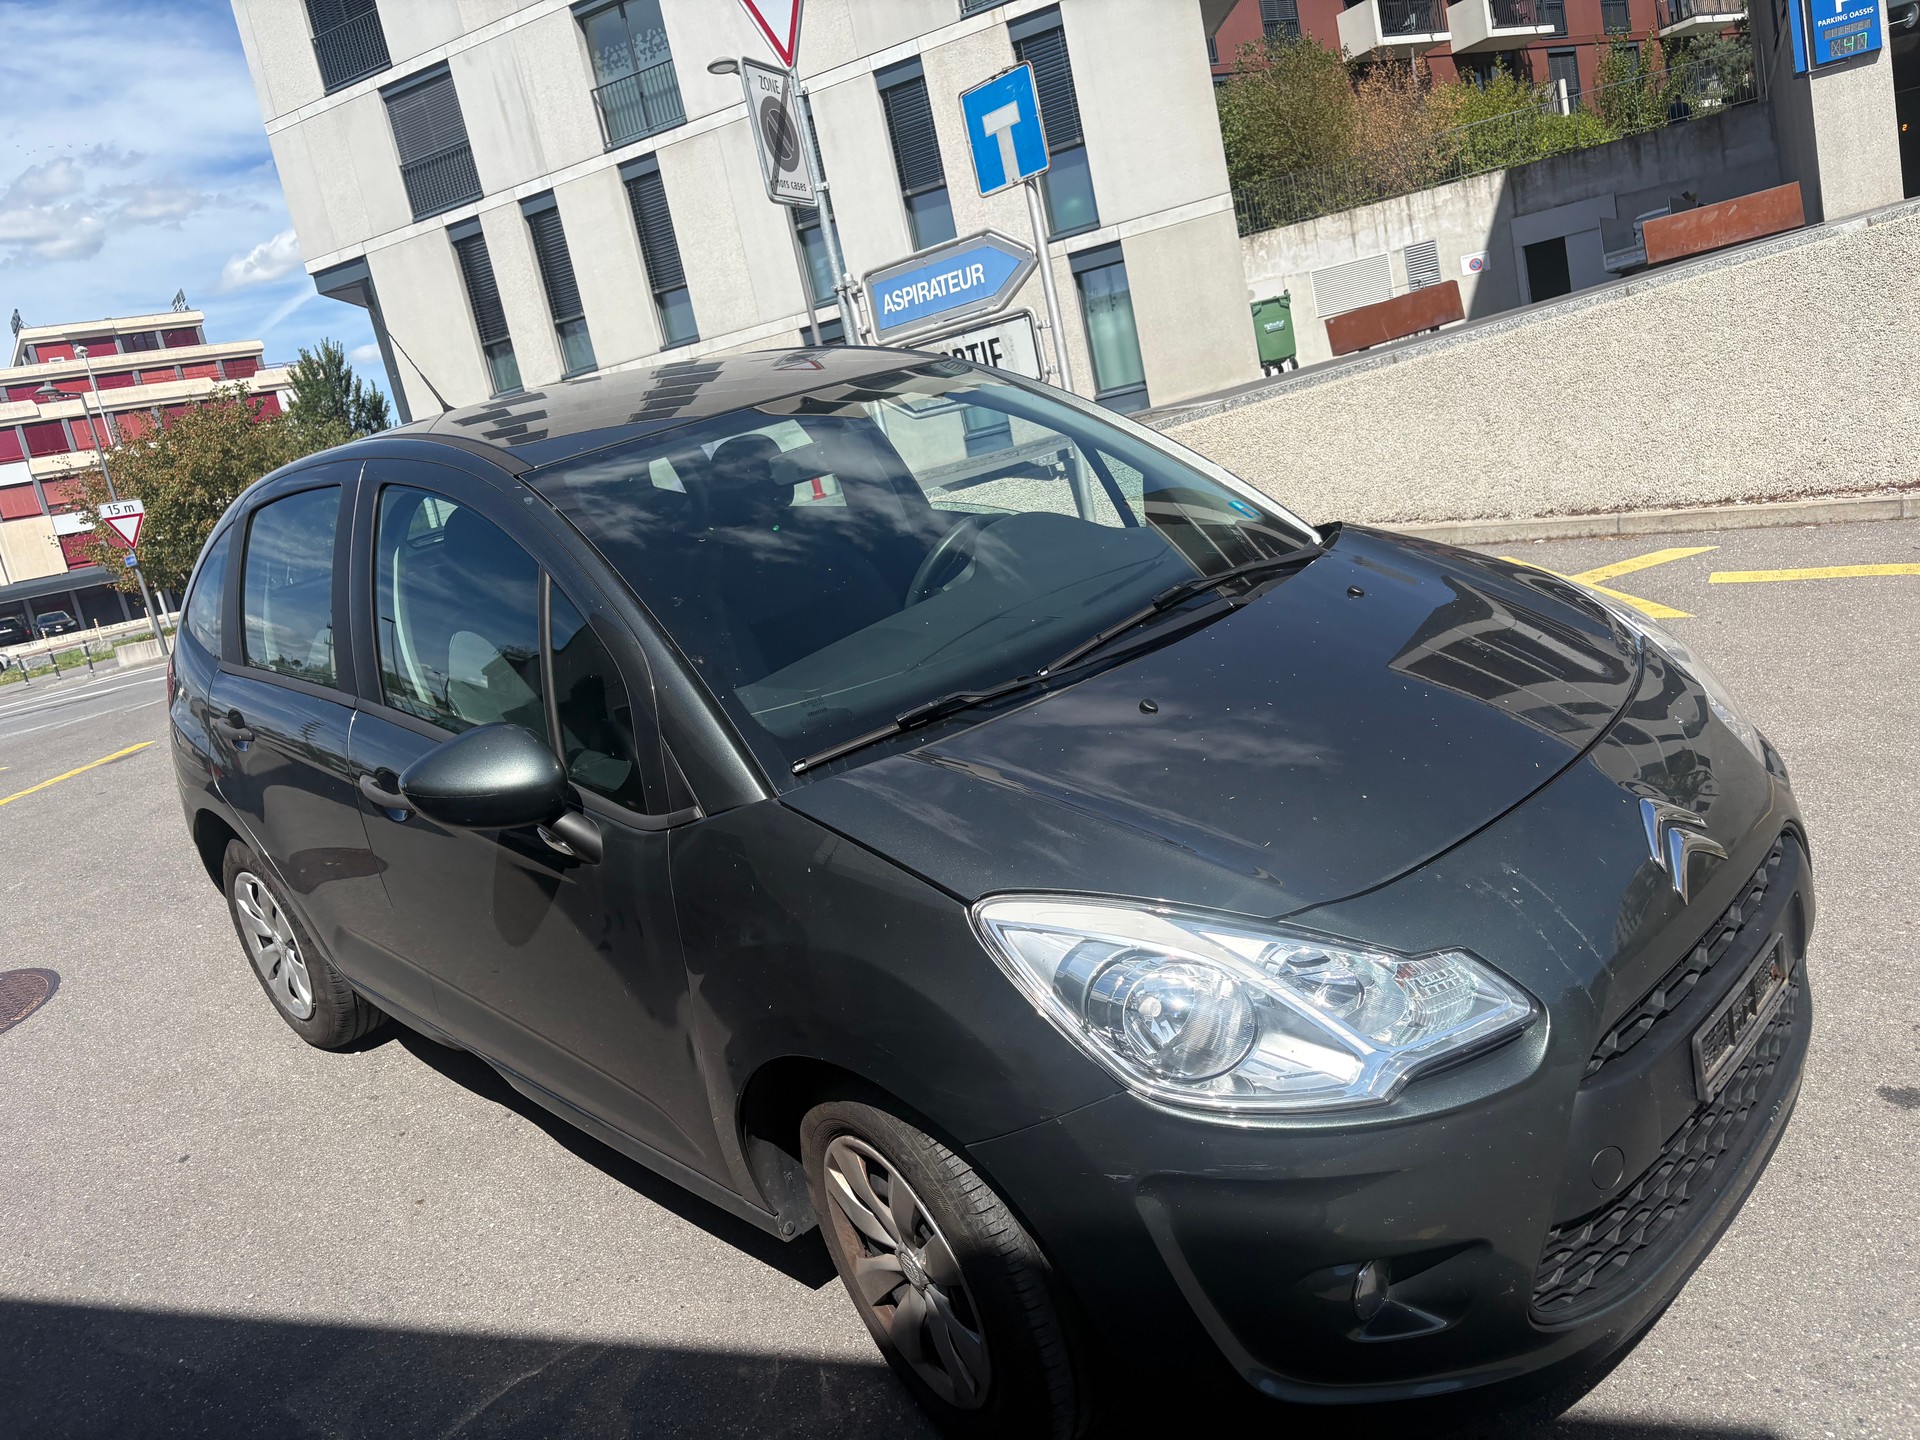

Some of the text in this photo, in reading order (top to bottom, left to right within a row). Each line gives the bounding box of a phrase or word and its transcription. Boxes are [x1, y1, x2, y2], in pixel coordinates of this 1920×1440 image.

[1817, 13, 1848, 28] PARKING
[1849, 6, 1875, 19] OASSIS
[758, 74, 781, 94] ZONE
[790, 181, 807, 192] cases
[883, 262, 986, 315] ASPIRATEUR
[939, 336, 1003, 368] TIE
[107, 504, 135, 515] 15 m
